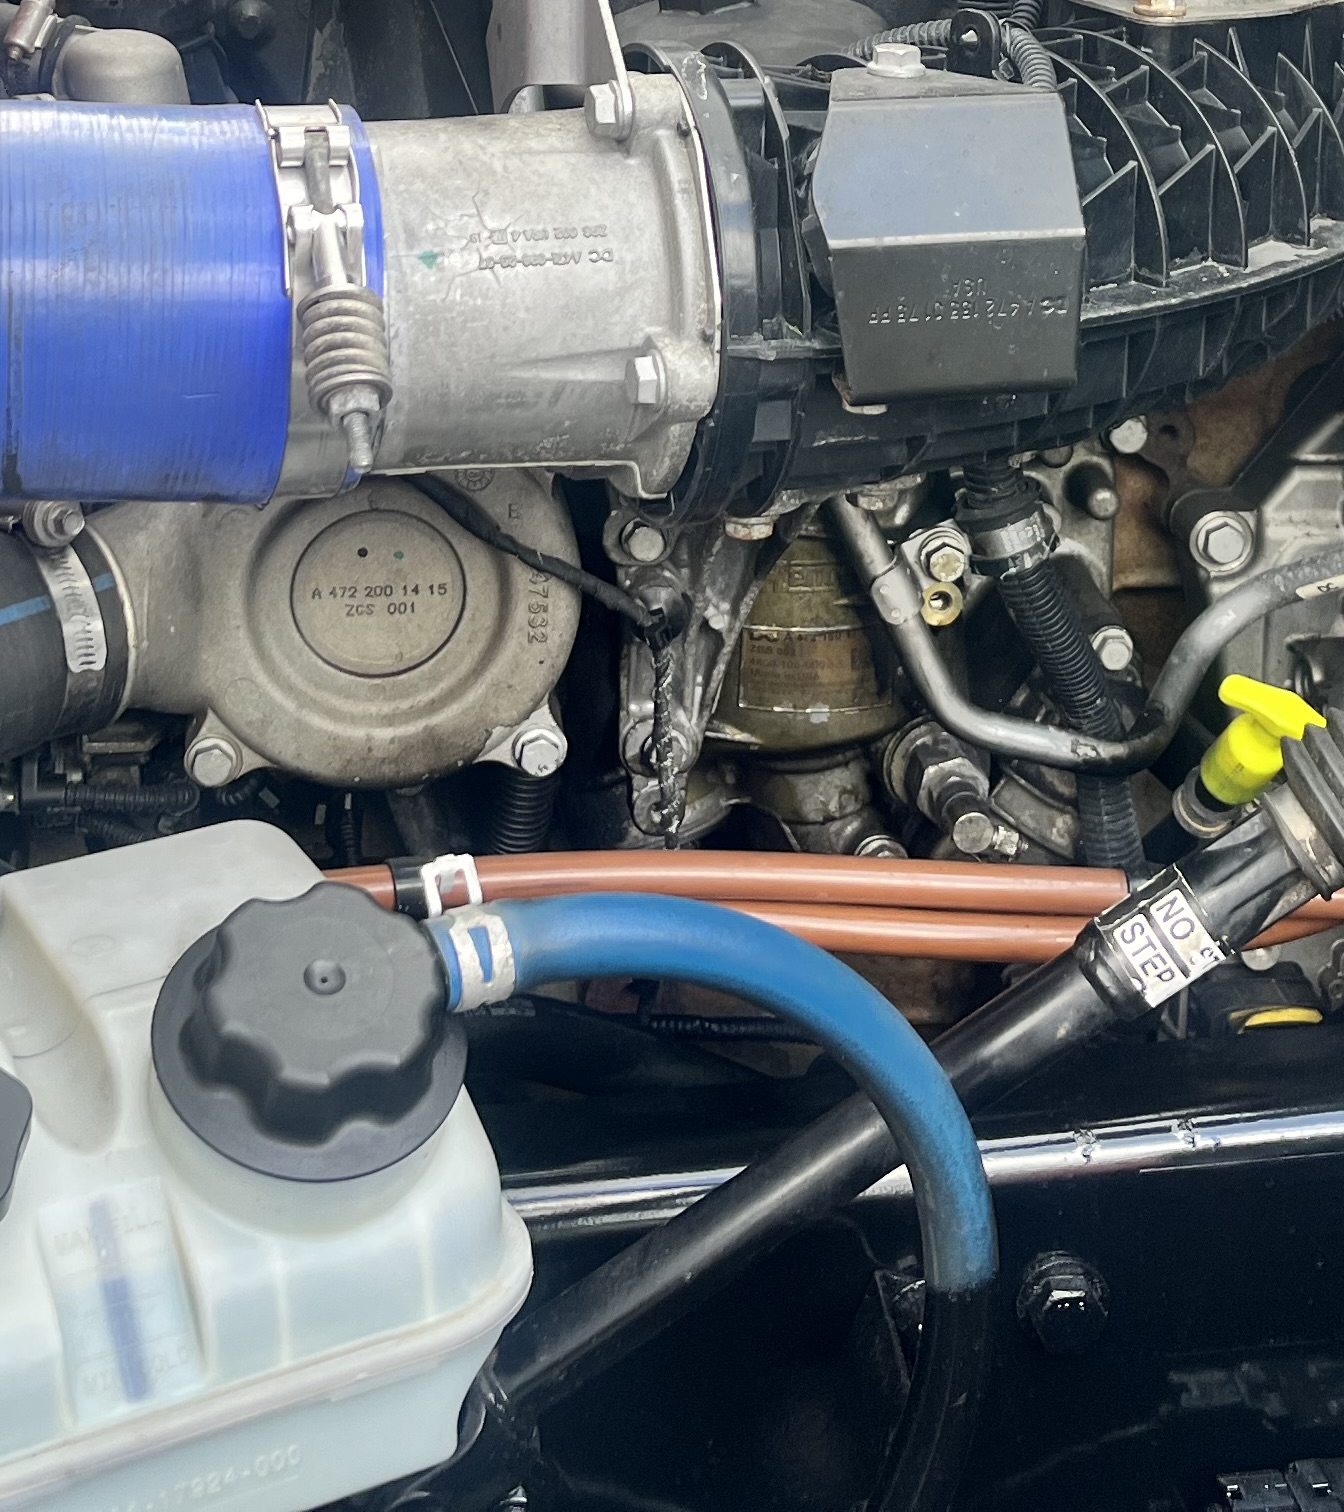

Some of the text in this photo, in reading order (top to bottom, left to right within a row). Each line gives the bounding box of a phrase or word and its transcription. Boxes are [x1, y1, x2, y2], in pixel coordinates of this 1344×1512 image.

[952, 277, 987, 298] USA
[312, 583, 448, 600] A 472 200 14 15
[387, 602, 416, 615] 001
[1155, 895, 1195, 940] NO
[1120, 921, 1176, 983] STEP
